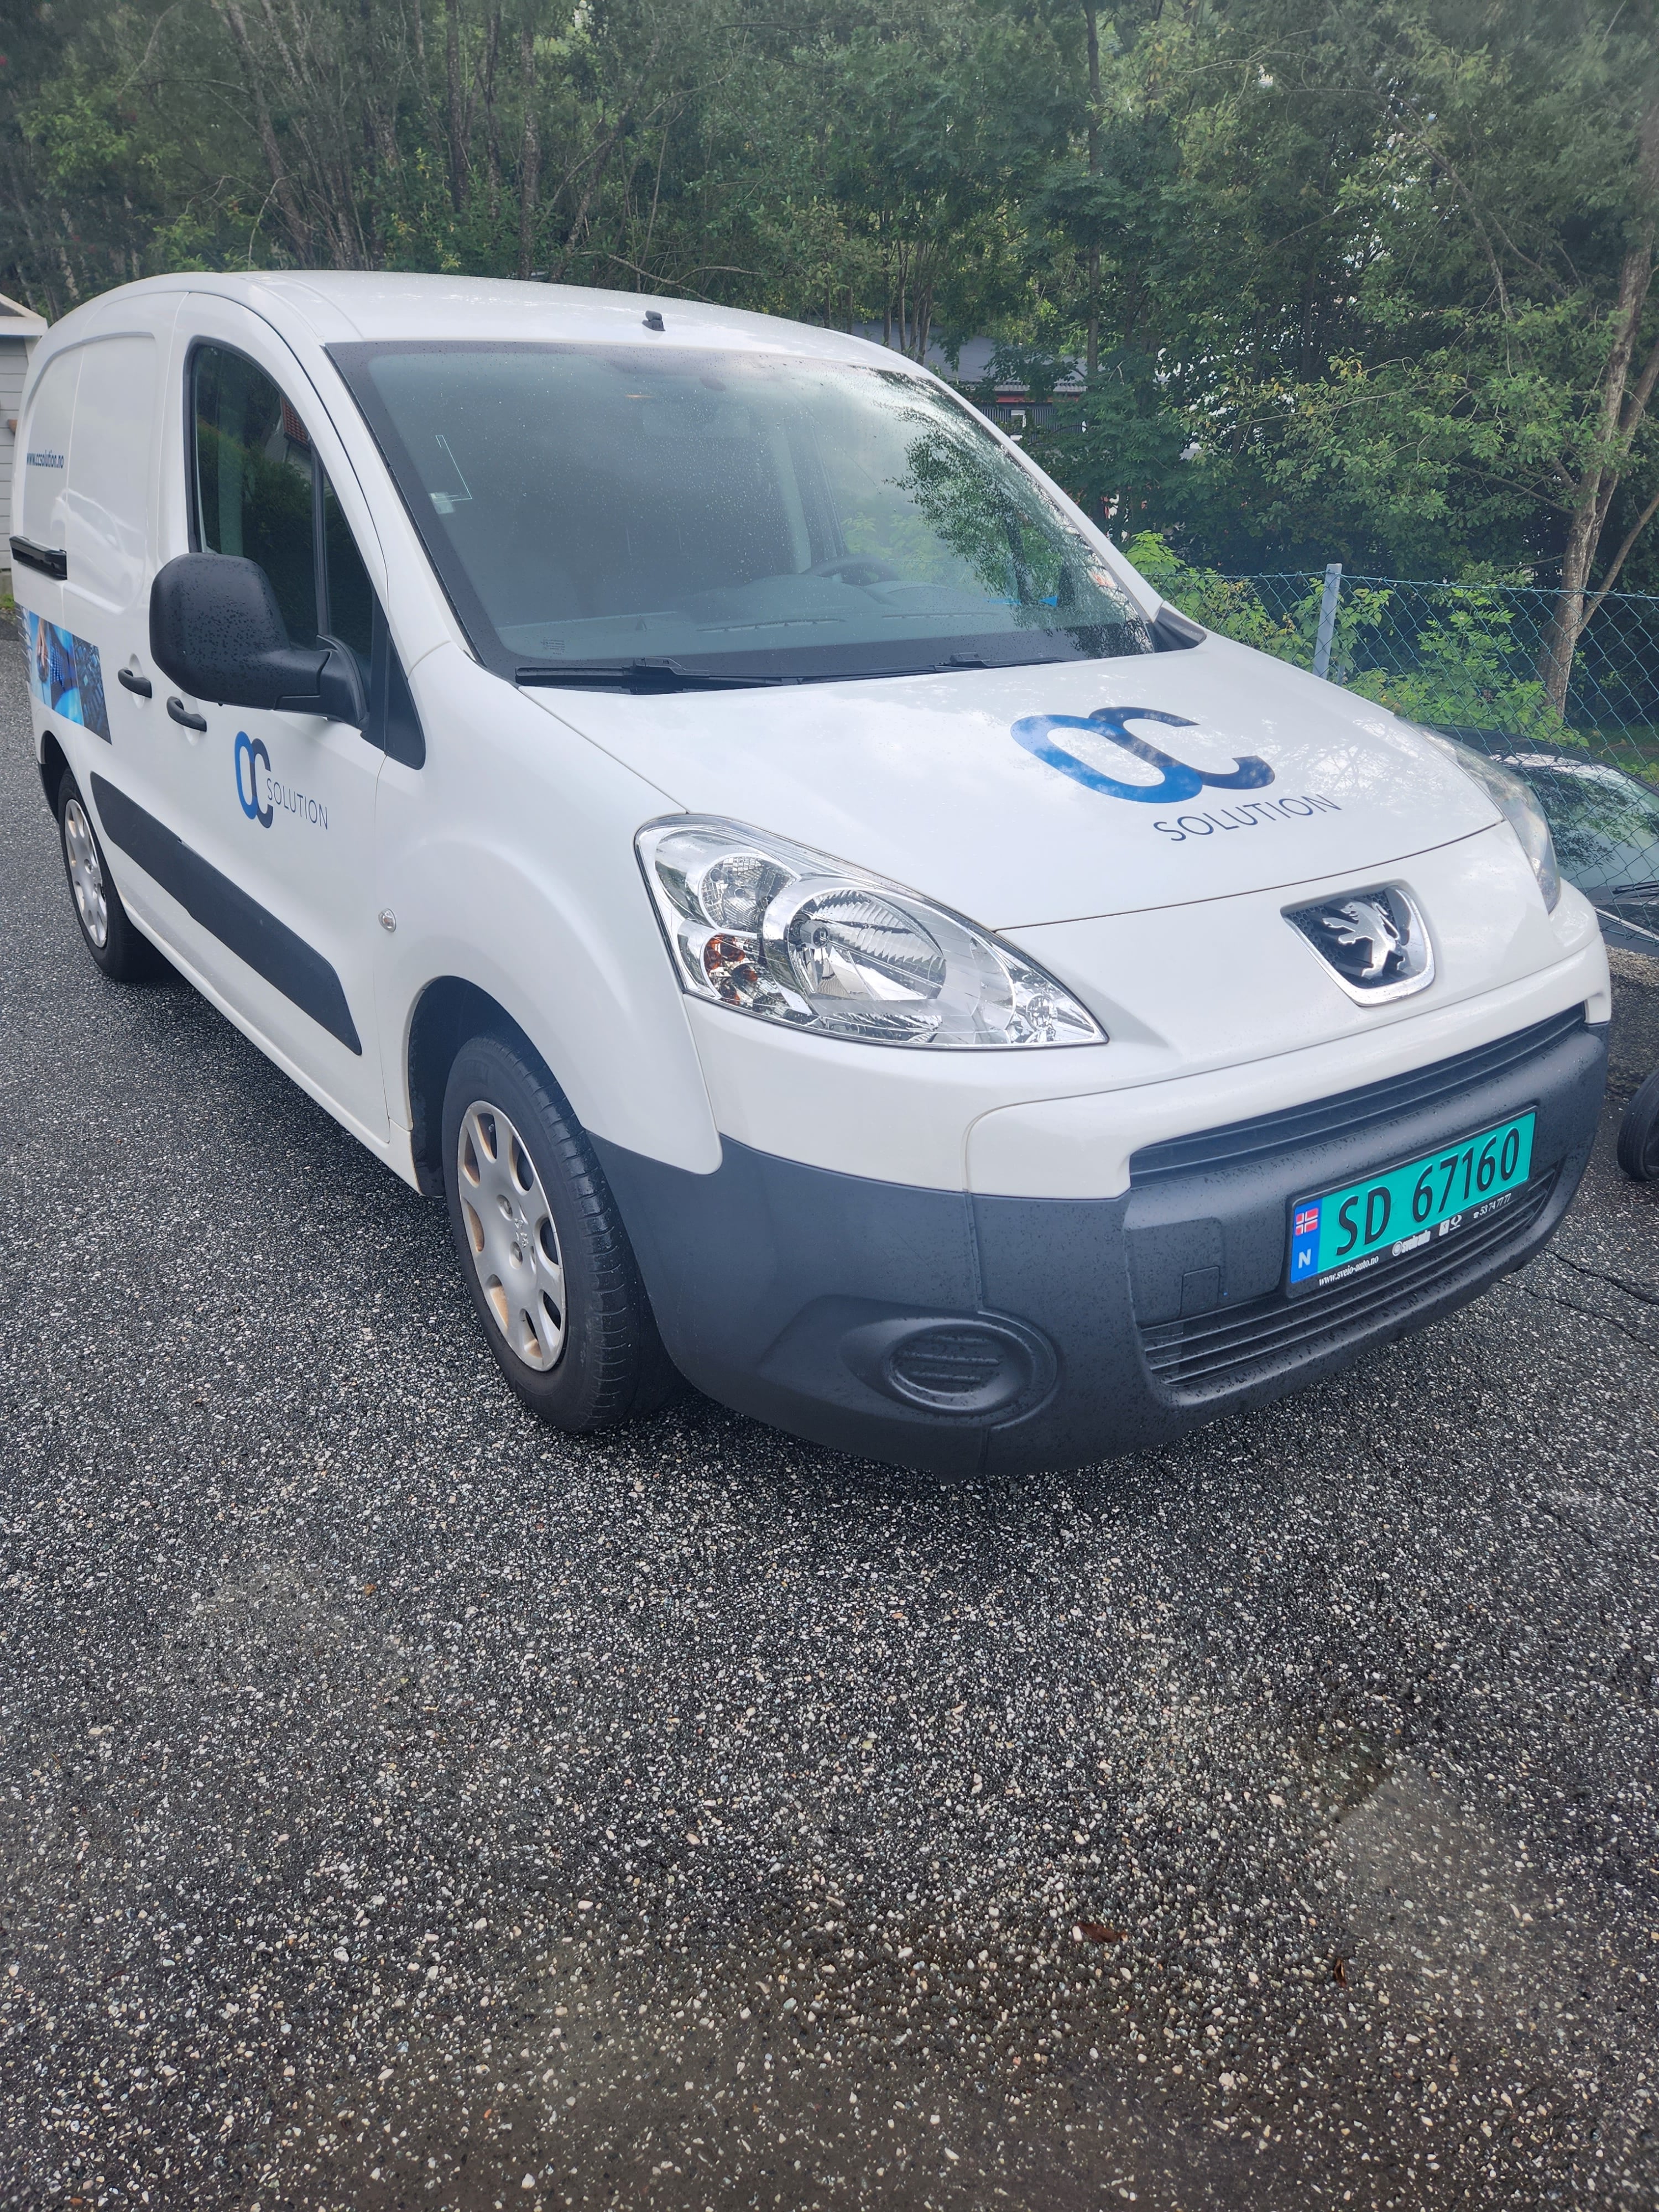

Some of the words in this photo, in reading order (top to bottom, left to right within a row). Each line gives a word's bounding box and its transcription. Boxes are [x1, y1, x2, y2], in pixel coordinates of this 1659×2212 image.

[267, 778, 328, 830] SOLUTION
[1152, 794, 1343, 841] SOLUTION
[1335, 1185, 1391, 1256] SD
[1412, 1127, 1520, 1223] 67160
[1298, 1248, 1311, 1269] N
[1318, 1256, 1379, 1286] www.sveio-auto.no
